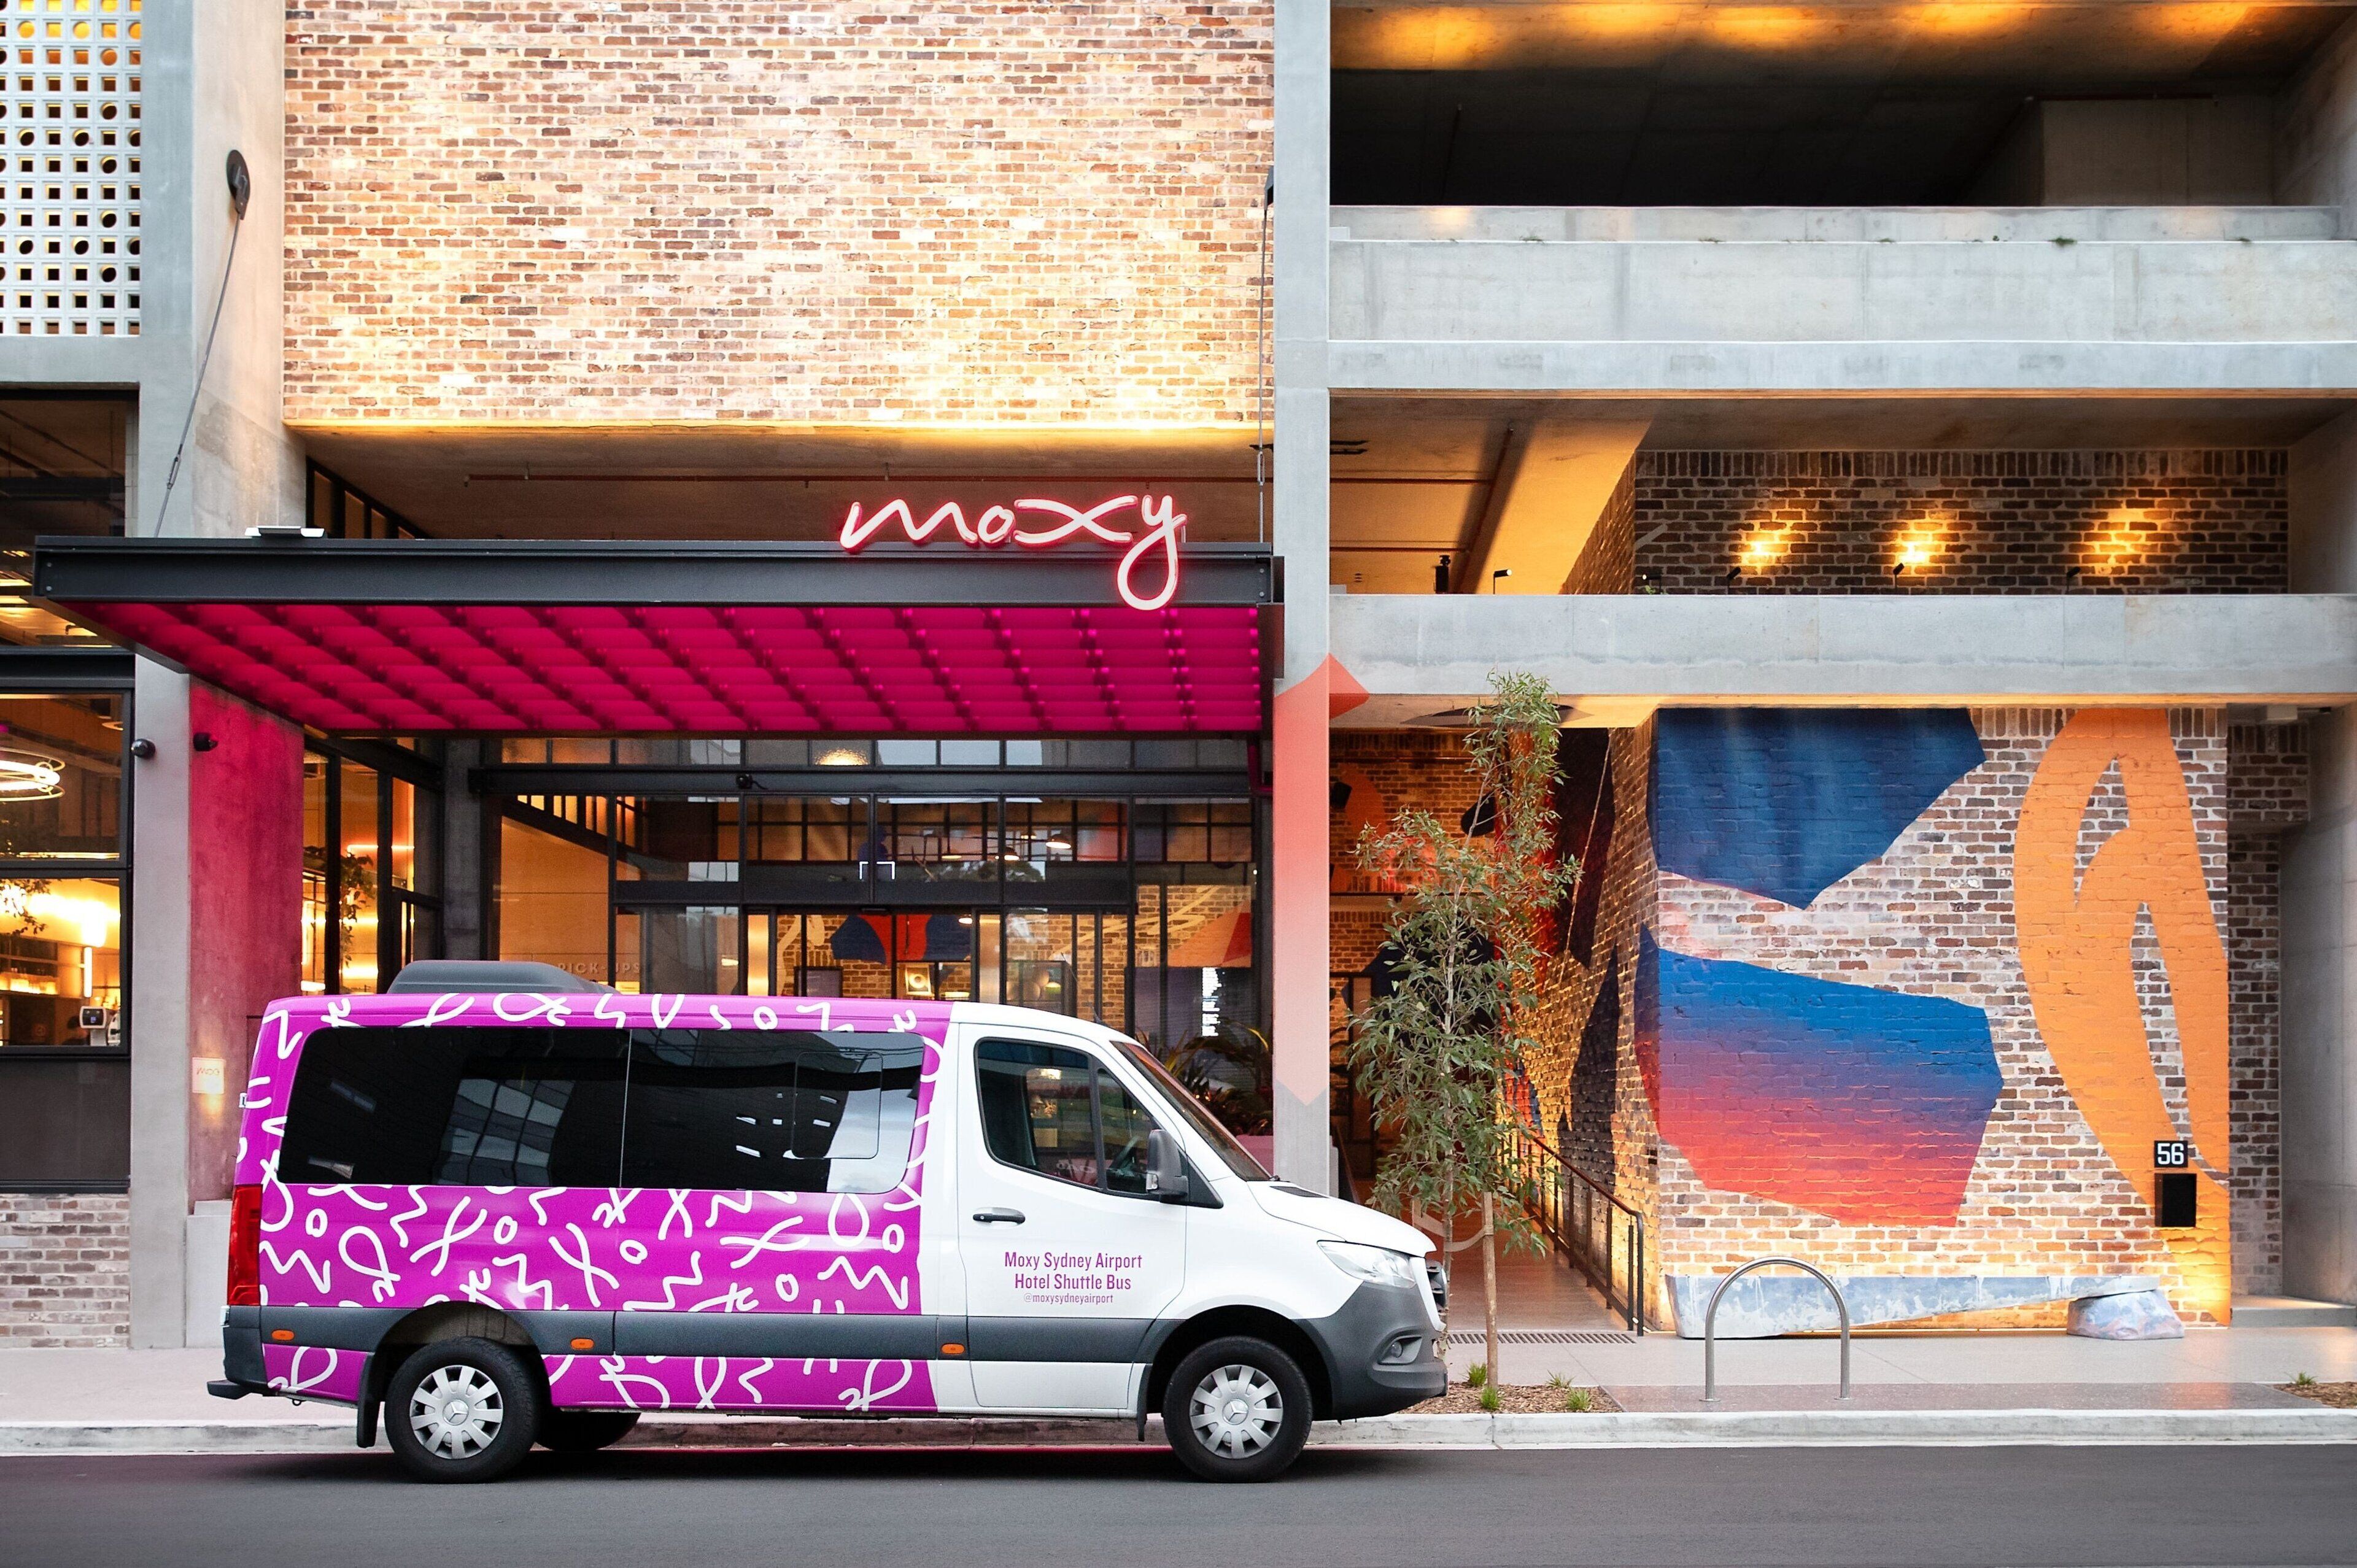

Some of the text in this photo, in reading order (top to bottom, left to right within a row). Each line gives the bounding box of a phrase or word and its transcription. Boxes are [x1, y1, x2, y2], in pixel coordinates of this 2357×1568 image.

[557, 962, 640, 974] PICK-PS
[2158, 1143, 2184, 1164] 56
[1005, 1252, 1142, 1271] Moxy Sydney Airport
[1015, 1273, 1131, 1289] Hotel Shuttle Bus
[1024, 1293, 1113, 1305] @moxysydneyairport
